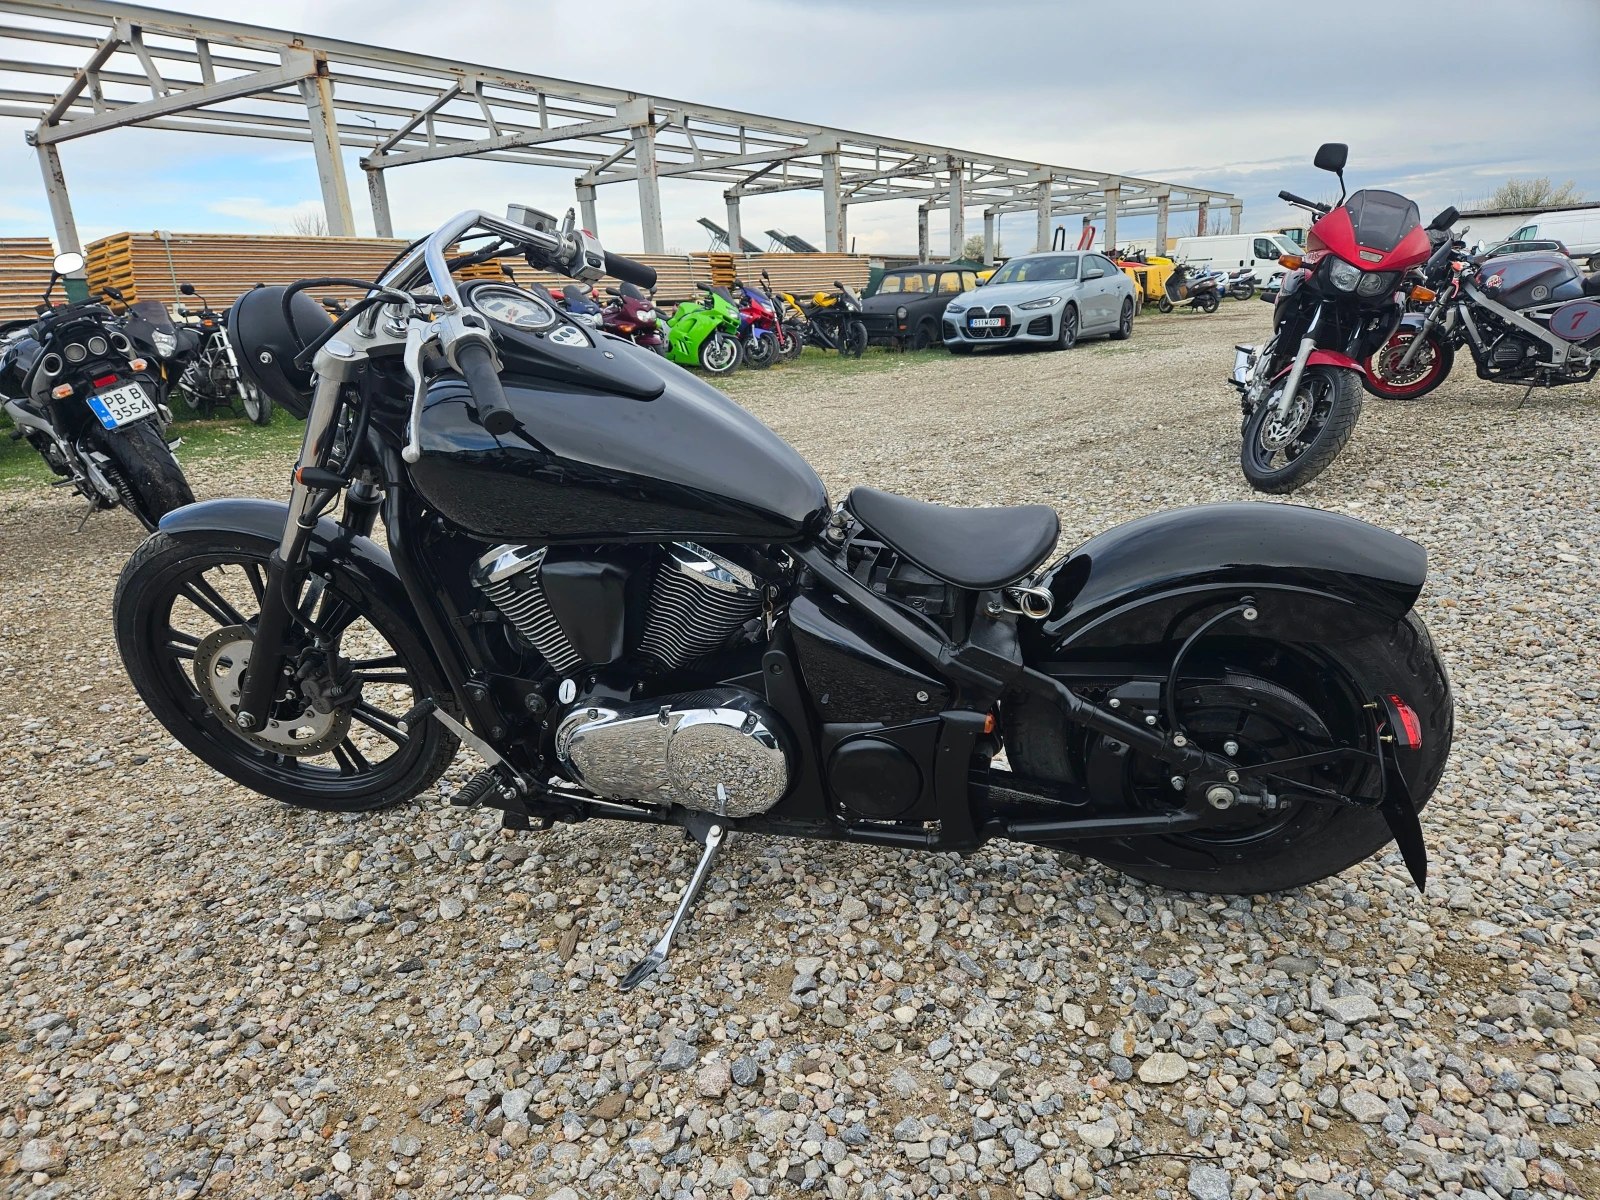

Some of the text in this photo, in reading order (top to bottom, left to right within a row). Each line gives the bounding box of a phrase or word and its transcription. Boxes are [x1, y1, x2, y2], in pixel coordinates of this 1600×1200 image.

[1571, 311, 1588, 330] 7
[103, 387, 142, 409] PB B
[112, 400, 151, 421] 3554
